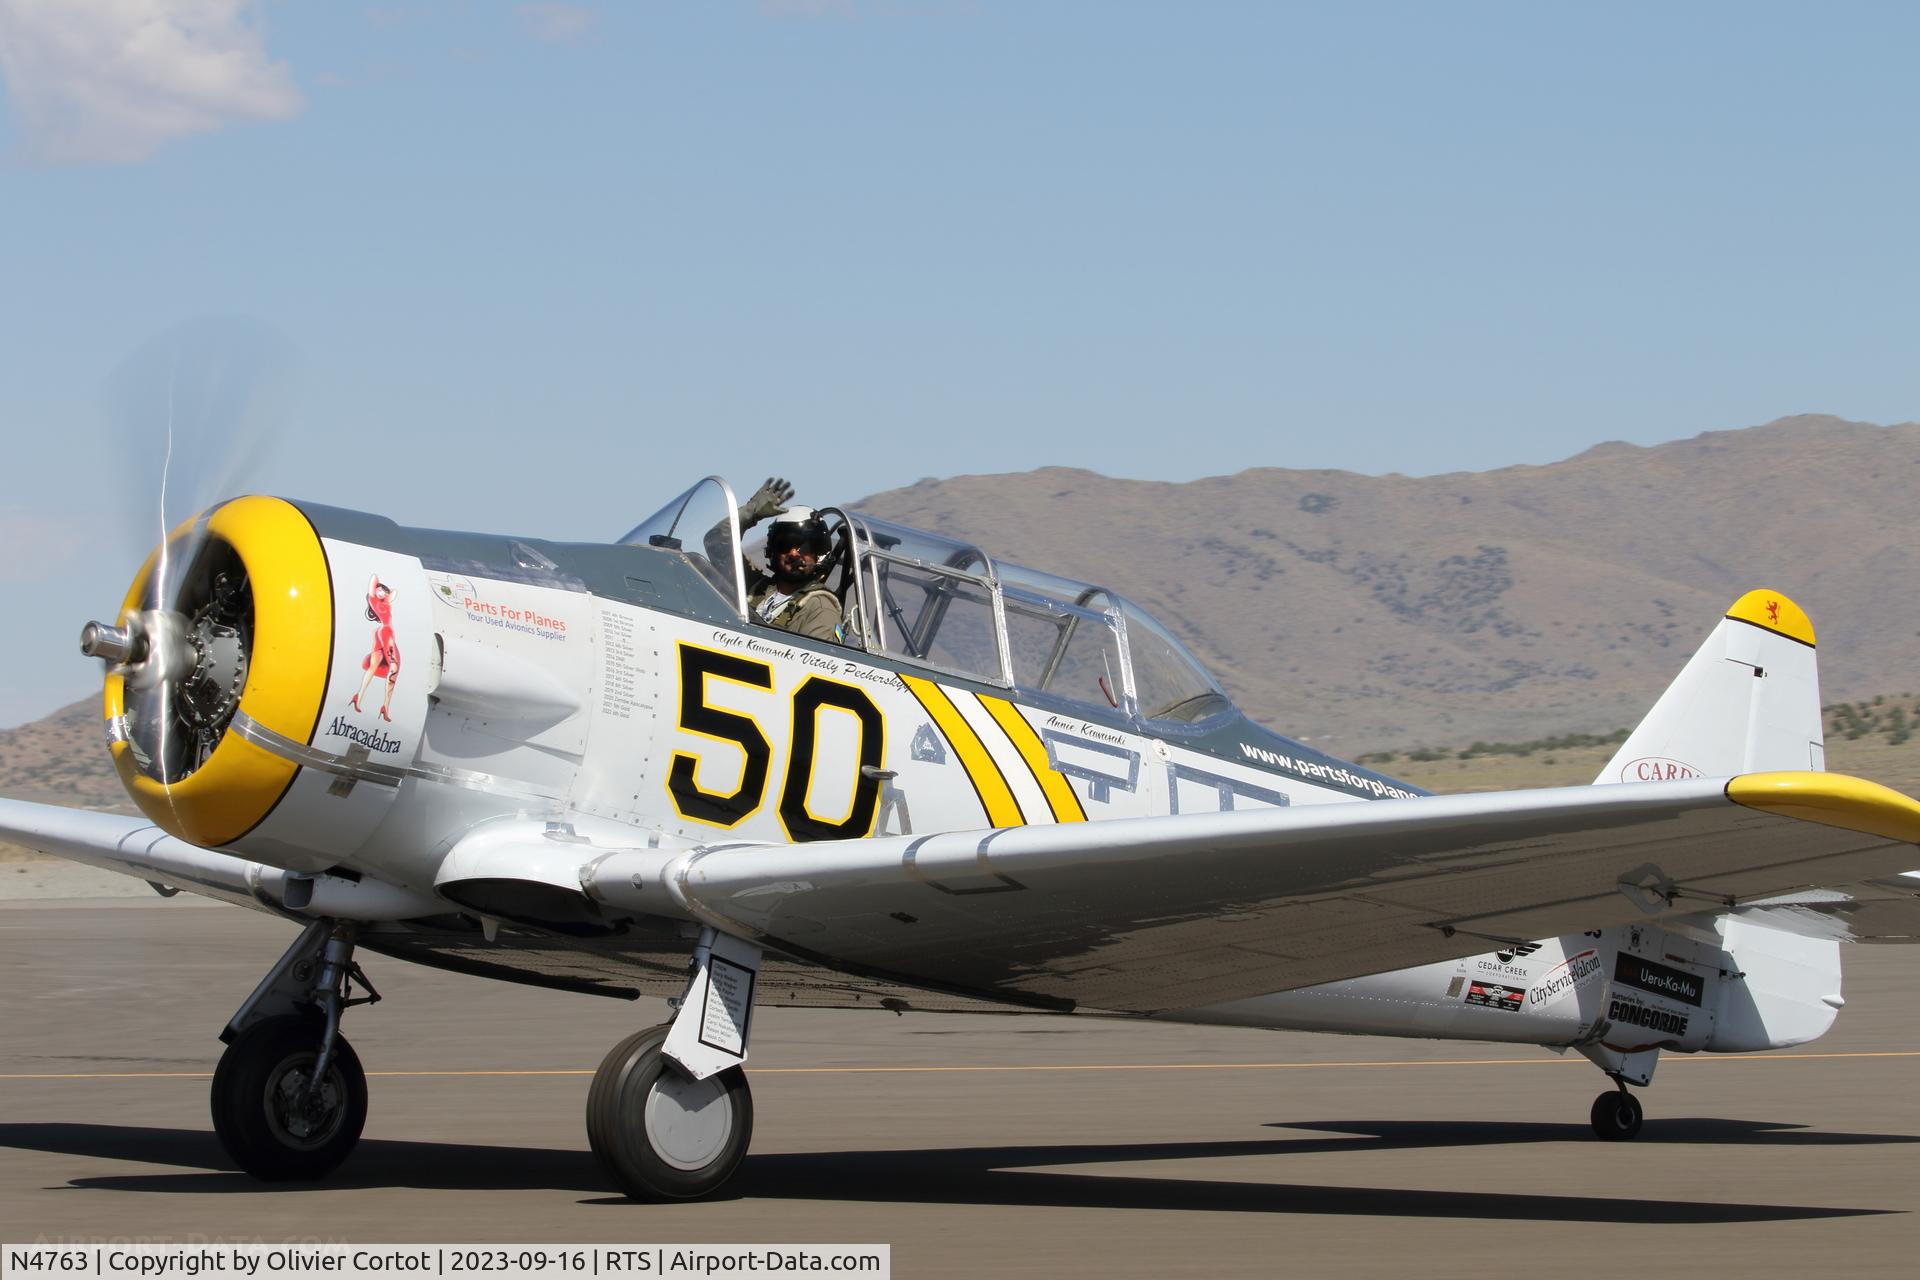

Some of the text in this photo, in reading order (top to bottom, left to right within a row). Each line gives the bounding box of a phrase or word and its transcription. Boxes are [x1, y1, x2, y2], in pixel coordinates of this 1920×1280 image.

[464, 598, 566, 631] Parts For Planes
[467, 611, 566, 641] Your Used Avionics Supplier
[712, 631, 743, 648] Clyde
[800, 653, 839, 673] Vitaly
[325, 716, 401, 753] Abracadabra
[664, 639, 888, 845] 50
[1047, 716, 1126, 745] Annie Kawasaki
[1240, 742, 1424, 800] www.partsforplan
[1638, 762, 1699, 780] CARD
[1478, 961, 1502, 972] CEDAR
[1505, 966, 1528, 976] CREEK
[1530, 956, 1600, 1006] CityServiceValcon
[1641, 968, 1696, 997] Ueru-Ka-Mu
[1608, 1000, 1688, 1037] CONCORDE
